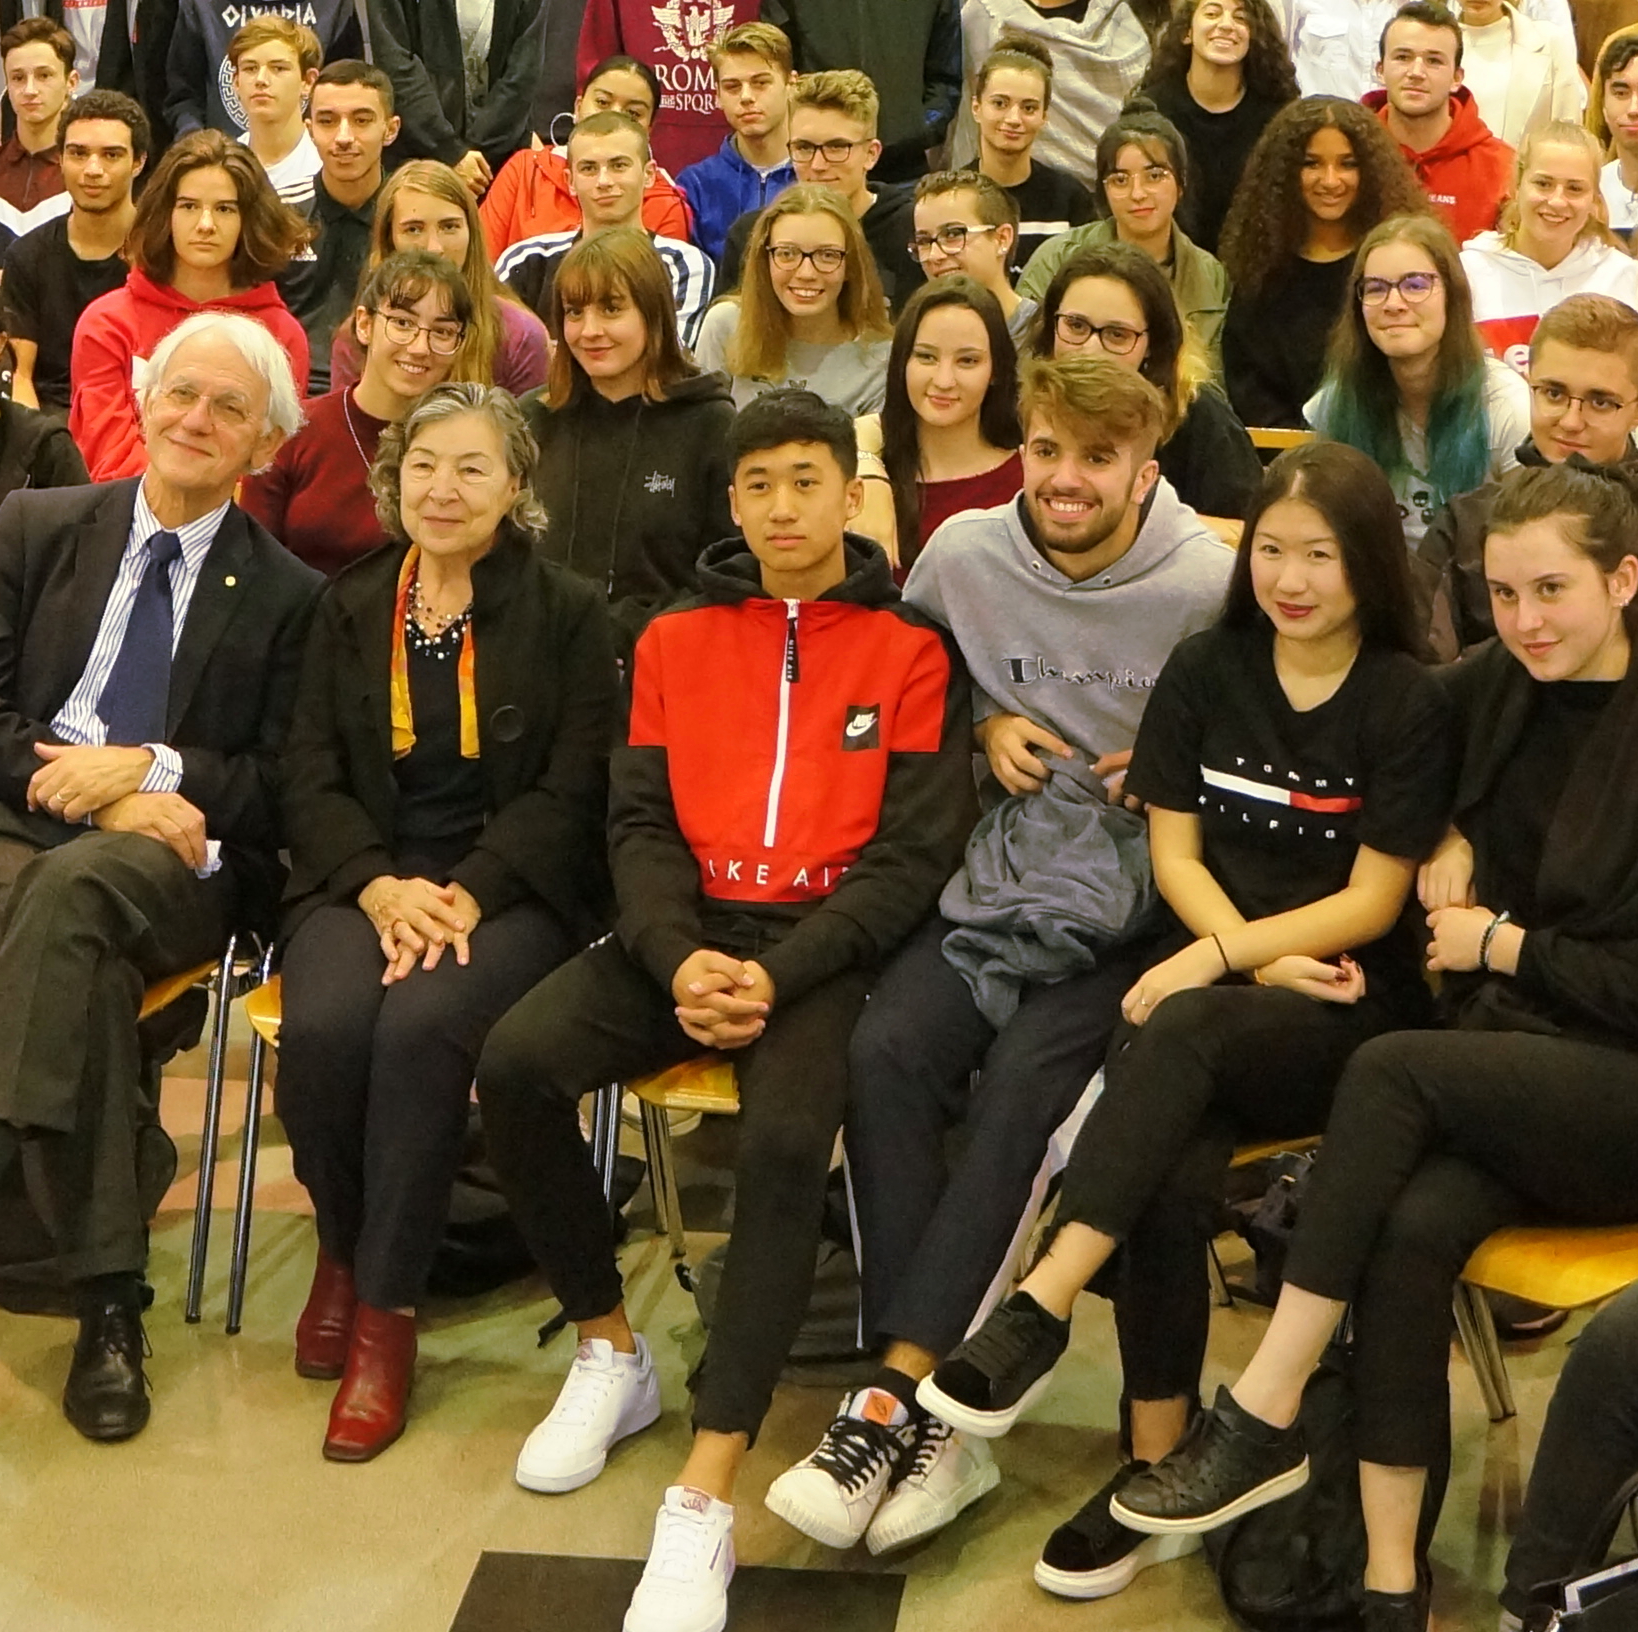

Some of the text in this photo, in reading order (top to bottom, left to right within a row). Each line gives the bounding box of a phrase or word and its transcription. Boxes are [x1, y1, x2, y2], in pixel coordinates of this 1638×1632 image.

[654, 63, 718, 92] ROM
[675, 93, 715, 115] SPQR
[1001, 656, 1159, 694] Champio
[1235, 756, 1355, 788] TOMMY
[1198, 795, 1337, 840] HILFIG
[708, 859, 770, 885] IKE
